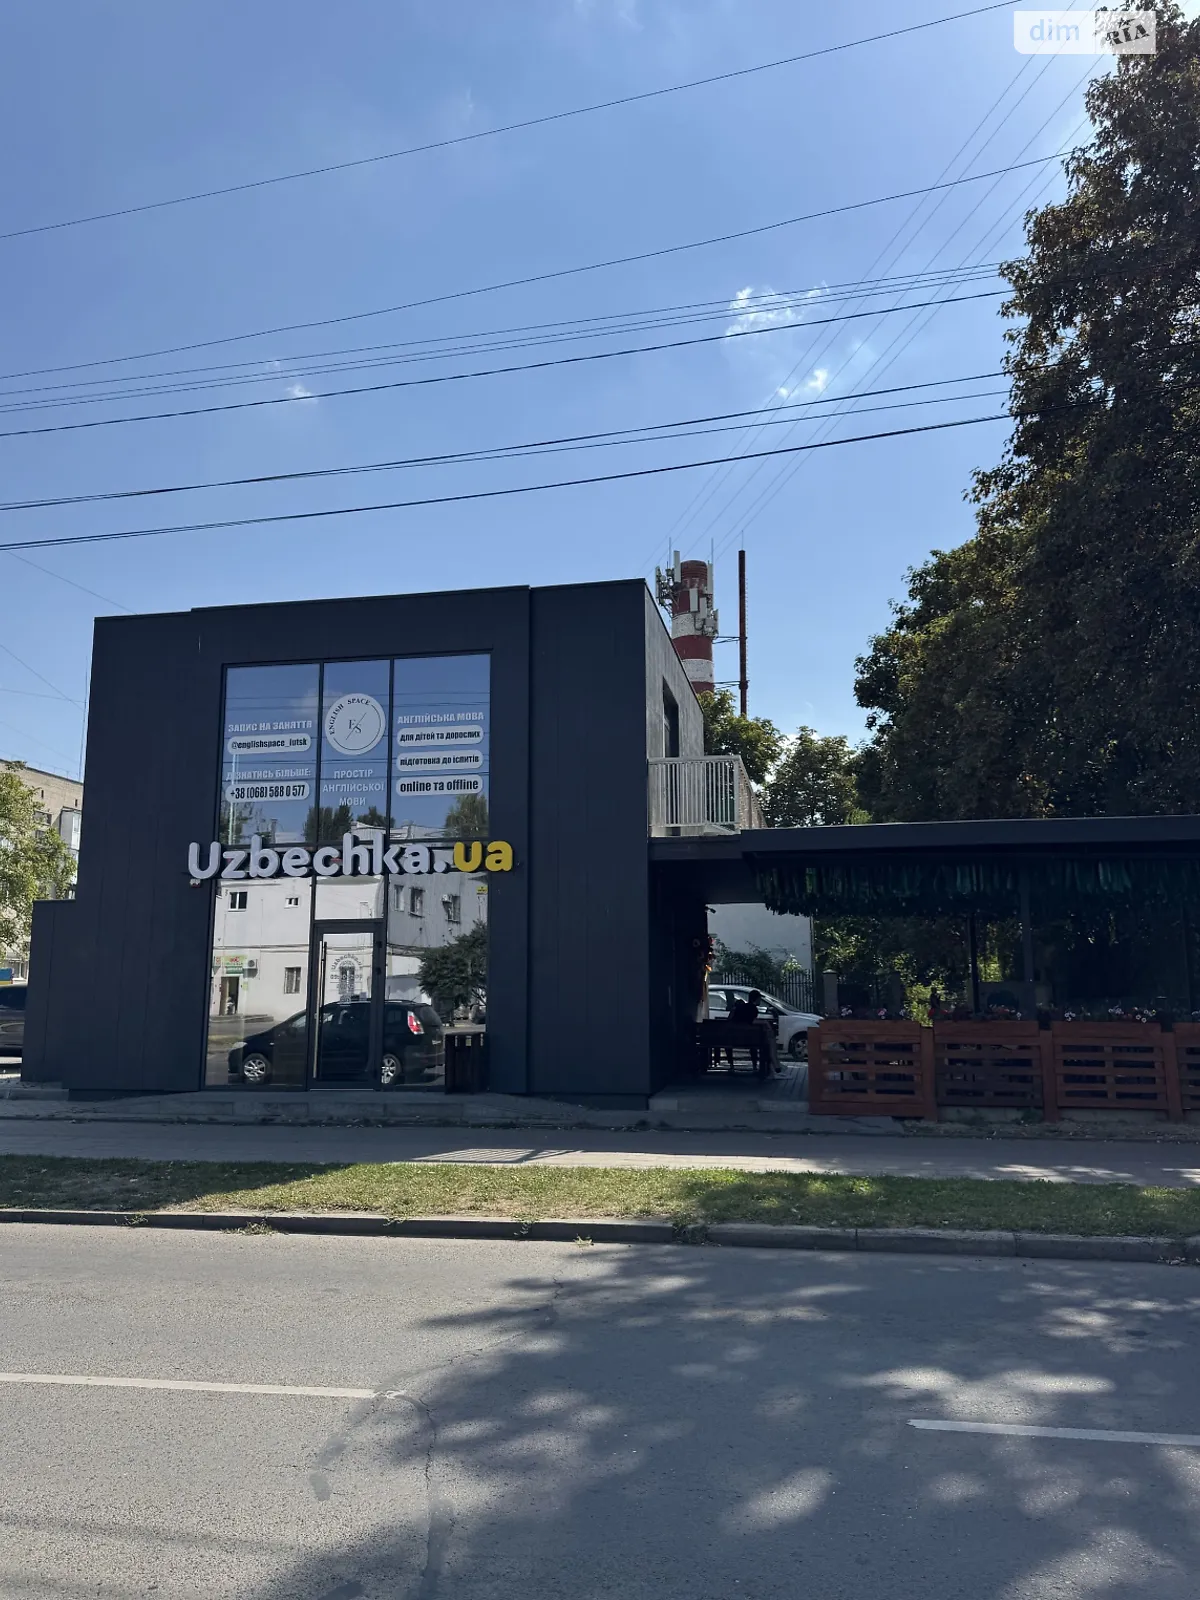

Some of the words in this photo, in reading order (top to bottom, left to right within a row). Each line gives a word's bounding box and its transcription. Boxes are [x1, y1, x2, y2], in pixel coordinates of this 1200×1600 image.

[328, 703, 344, 736] ENGLISH
[347, 698, 371, 706] SPACE
[398, 713, 456, 724] АНГЛІЙСЬКА
[457, 711, 484, 721] МОВА
[228, 723, 258, 732] ЗАПИС
[259, 722, 271, 731] НА
[272, 720, 313, 730] ЗАНЯТТЯ
[400, 733, 414, 743] для
[415, 731, 435, 741] дітей
[436, 732, 445, 740] та
[446, 730, 480, 740] дорослих
[231, 738, 308, 750] @englishspace_lutsk
[400, 757, 441, 767] підготовка
[442, 756, 452, 765] до
[453, 754, 479, 764] іспитів
[275, 768, 312, 778] БІЛЬШЕ:
[333, 769, 373, 779] ПРОСТІР
[230, 787, 246, 799] +38
[246, 786, 268, 798] (068)
[269, 785, 284, 797] 588
[285, 785, 291, 797] 0
[292, 784, 306, 796] 577
[322, 782, 384, 793] АНГЛІЙСЬКОЇ
[400, 780, 432, 793] online
[433, 782, 445, 791] та
[446, 779, 479, 791] offline
[339, 797, 366, 806] МОВИ
[188, 832, 513, 880] Uzbechka.ua
